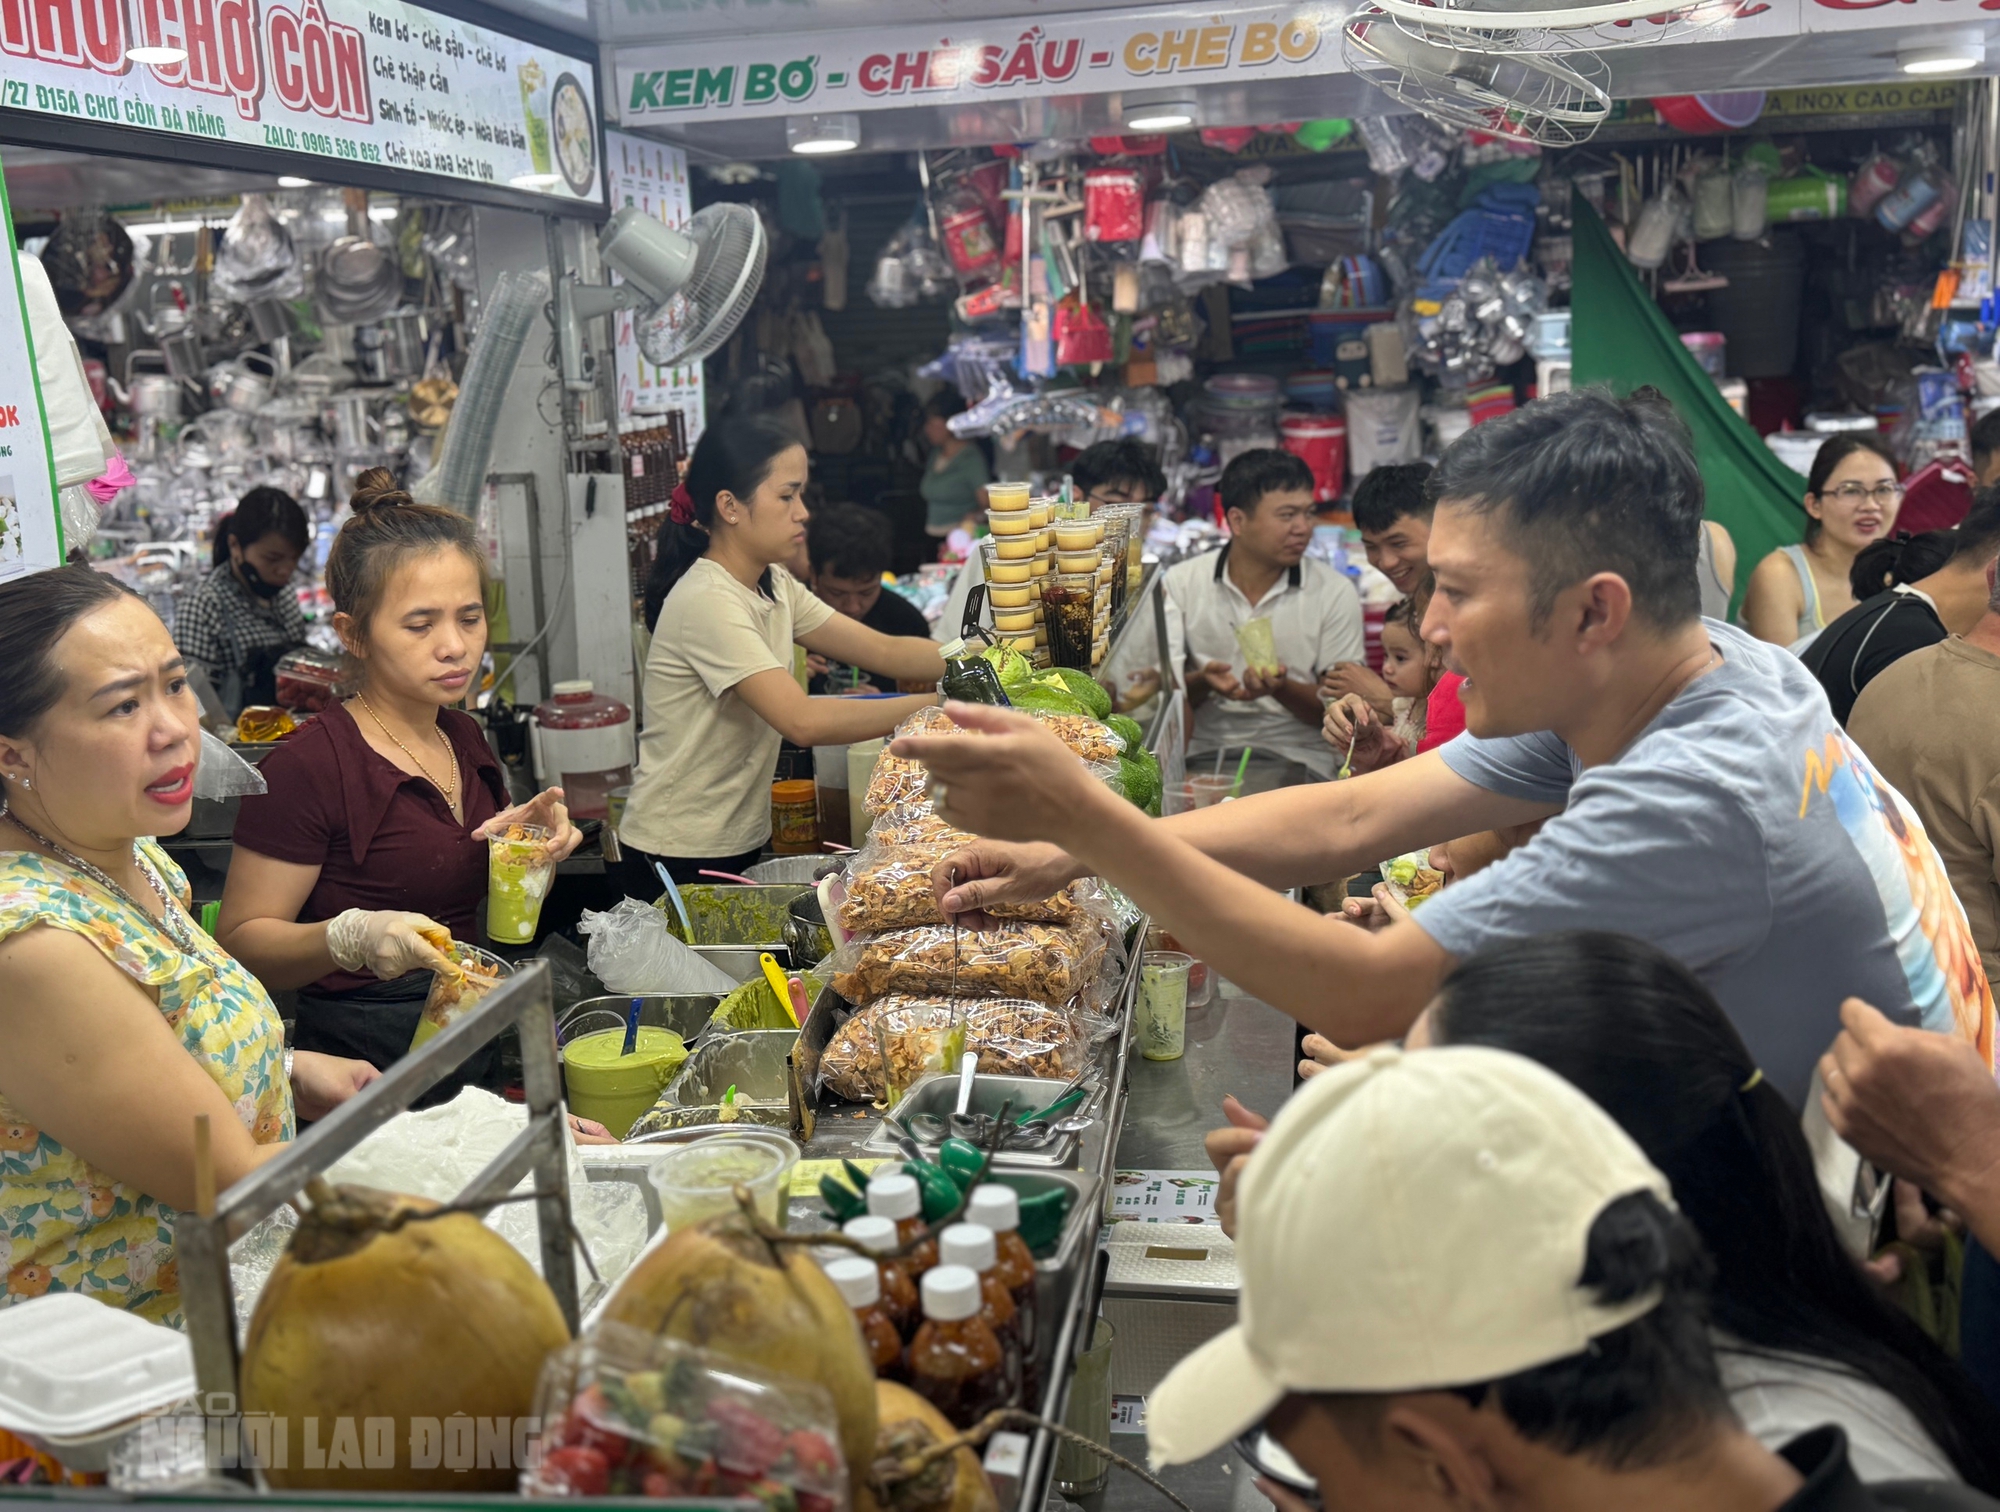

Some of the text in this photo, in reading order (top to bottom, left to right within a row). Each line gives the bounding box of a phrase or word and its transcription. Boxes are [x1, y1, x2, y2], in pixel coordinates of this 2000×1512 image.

[368, 10, 392, 38] Kem
[422, 28, 442, 53] chè
[475, 46, 493, 68] chè
[373, 54, 396, 80] Chè
[399, 61, 426, 92] thập
[628, 65, 737, 111] KEM
[743, 54, 818, 102] BƠ
[826, 71, 846, 85] -
[857, 37, 961, 93] CHÈ
[971, 25, 1081, 86] SẦU
[1090, 51, 1110, 64] -
[1122, 15, 1234, 73] CHÈ
[36, 84, 81, 115] Đ15A
[124, 92, 158, 127] CỒN
[161, 102, 184, 131] ĐÀ
[379, 98, 403, 124] Sinh
[1795, 91, 1847, 110] INOX
[1854, 89, 1902, 108] CAO
[263, 124, 382, 163] ZALO: 0905 536 852
[385, 140, 408, 165] Chè
